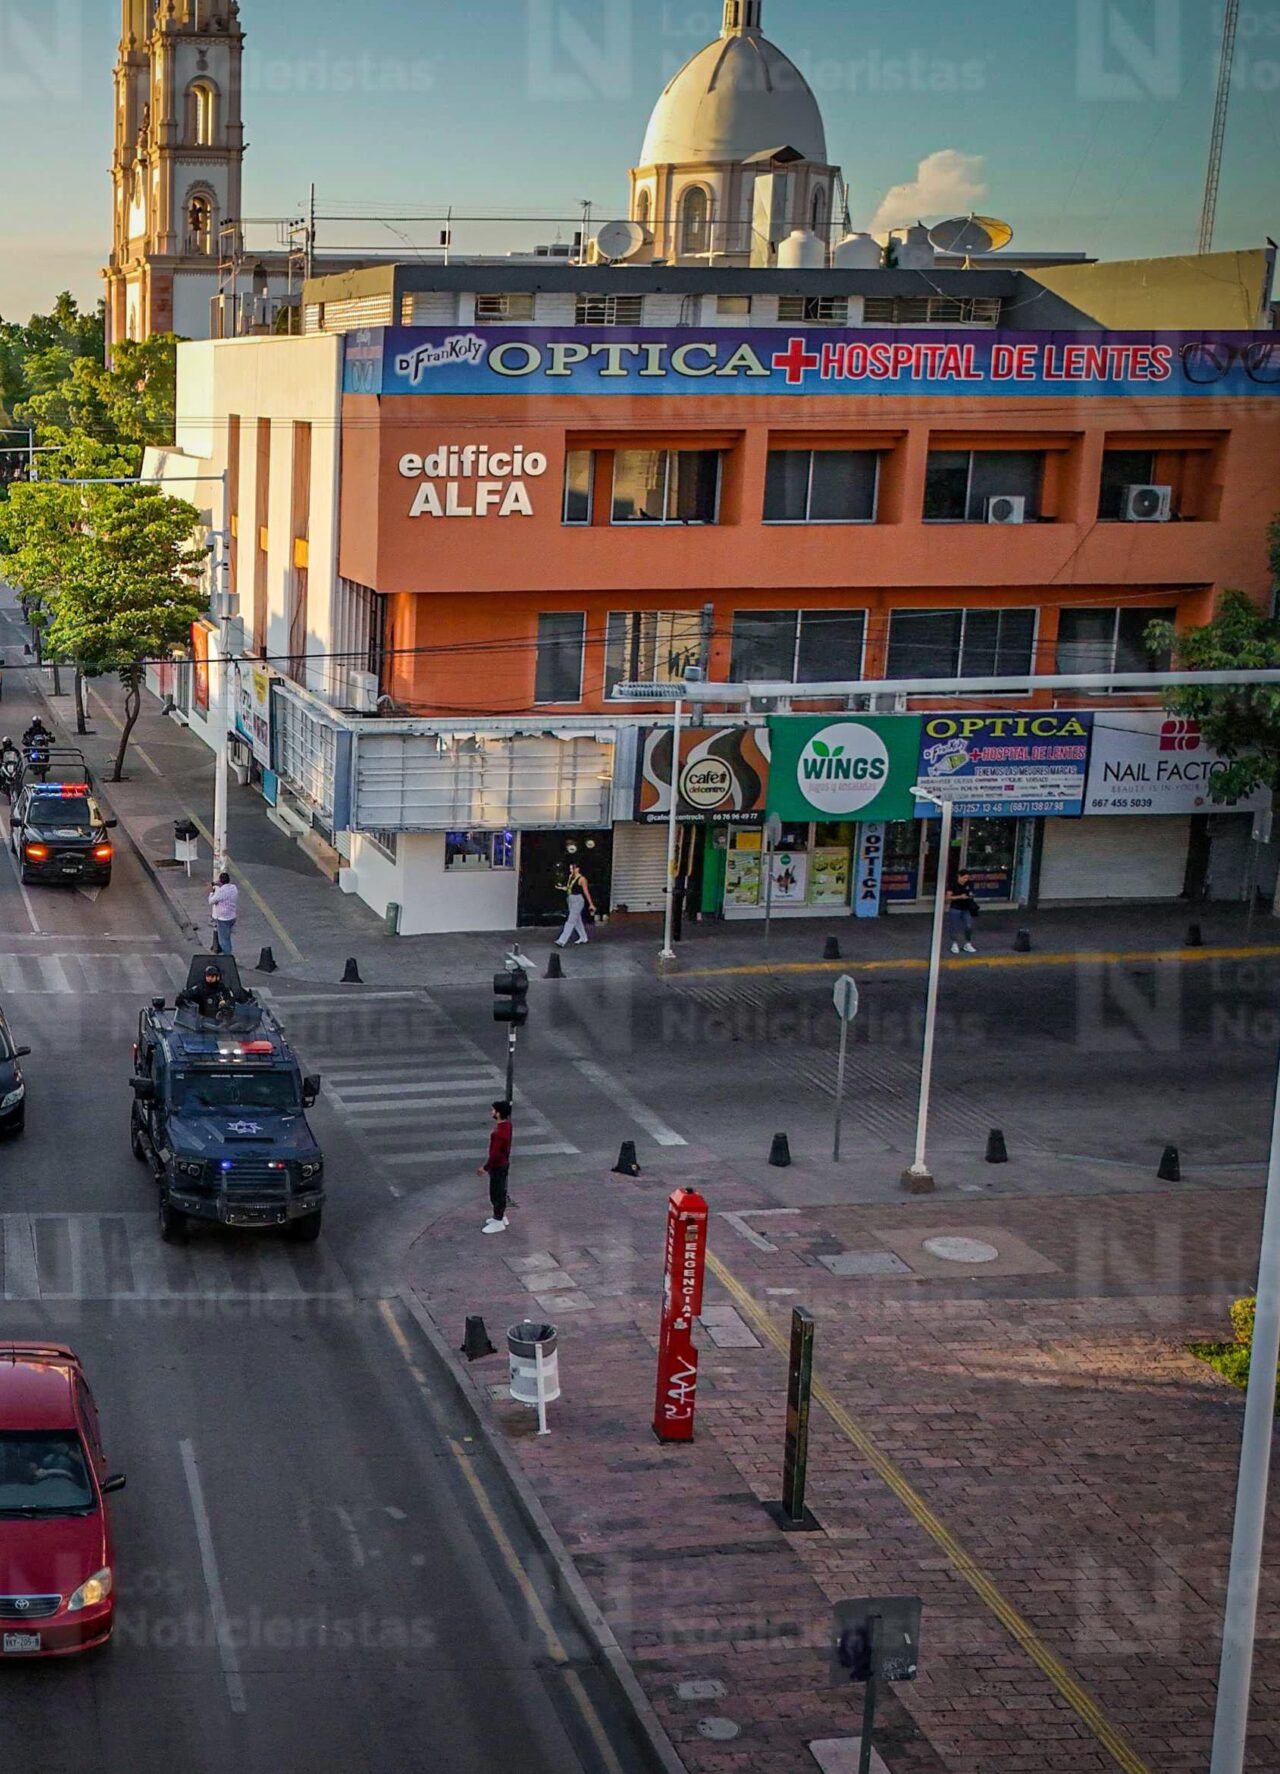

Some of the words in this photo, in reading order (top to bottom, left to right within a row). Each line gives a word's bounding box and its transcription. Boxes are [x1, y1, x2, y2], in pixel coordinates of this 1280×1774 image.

[488, 342, 771, 377] OPTICA
[821, 342, 983, 380] HOSPITAL
[990, 344, 1037, 380] DE
[1043, 344, 1173, 381] LENTES
[399, 445, 547, 478] edificio
[408, 482, 535, 517] ALFA
[925, 717, 1088, 738] OPTICA
[981, 746, 1030, 761] HOSPITAL
[1032, 746, 1046, 760] DE
[1047, 745, 1088, 760] LENTES
[802, 757, 886, 780] WINGS
[1103, 761, 1150, 782] NAIL
[1092, 799, 1109, 807] 667
[1111, 798, 1128, 807] 455
[1130, 798, 1153, 807] 5039
[861, 834, 879, 901] OPTICA
